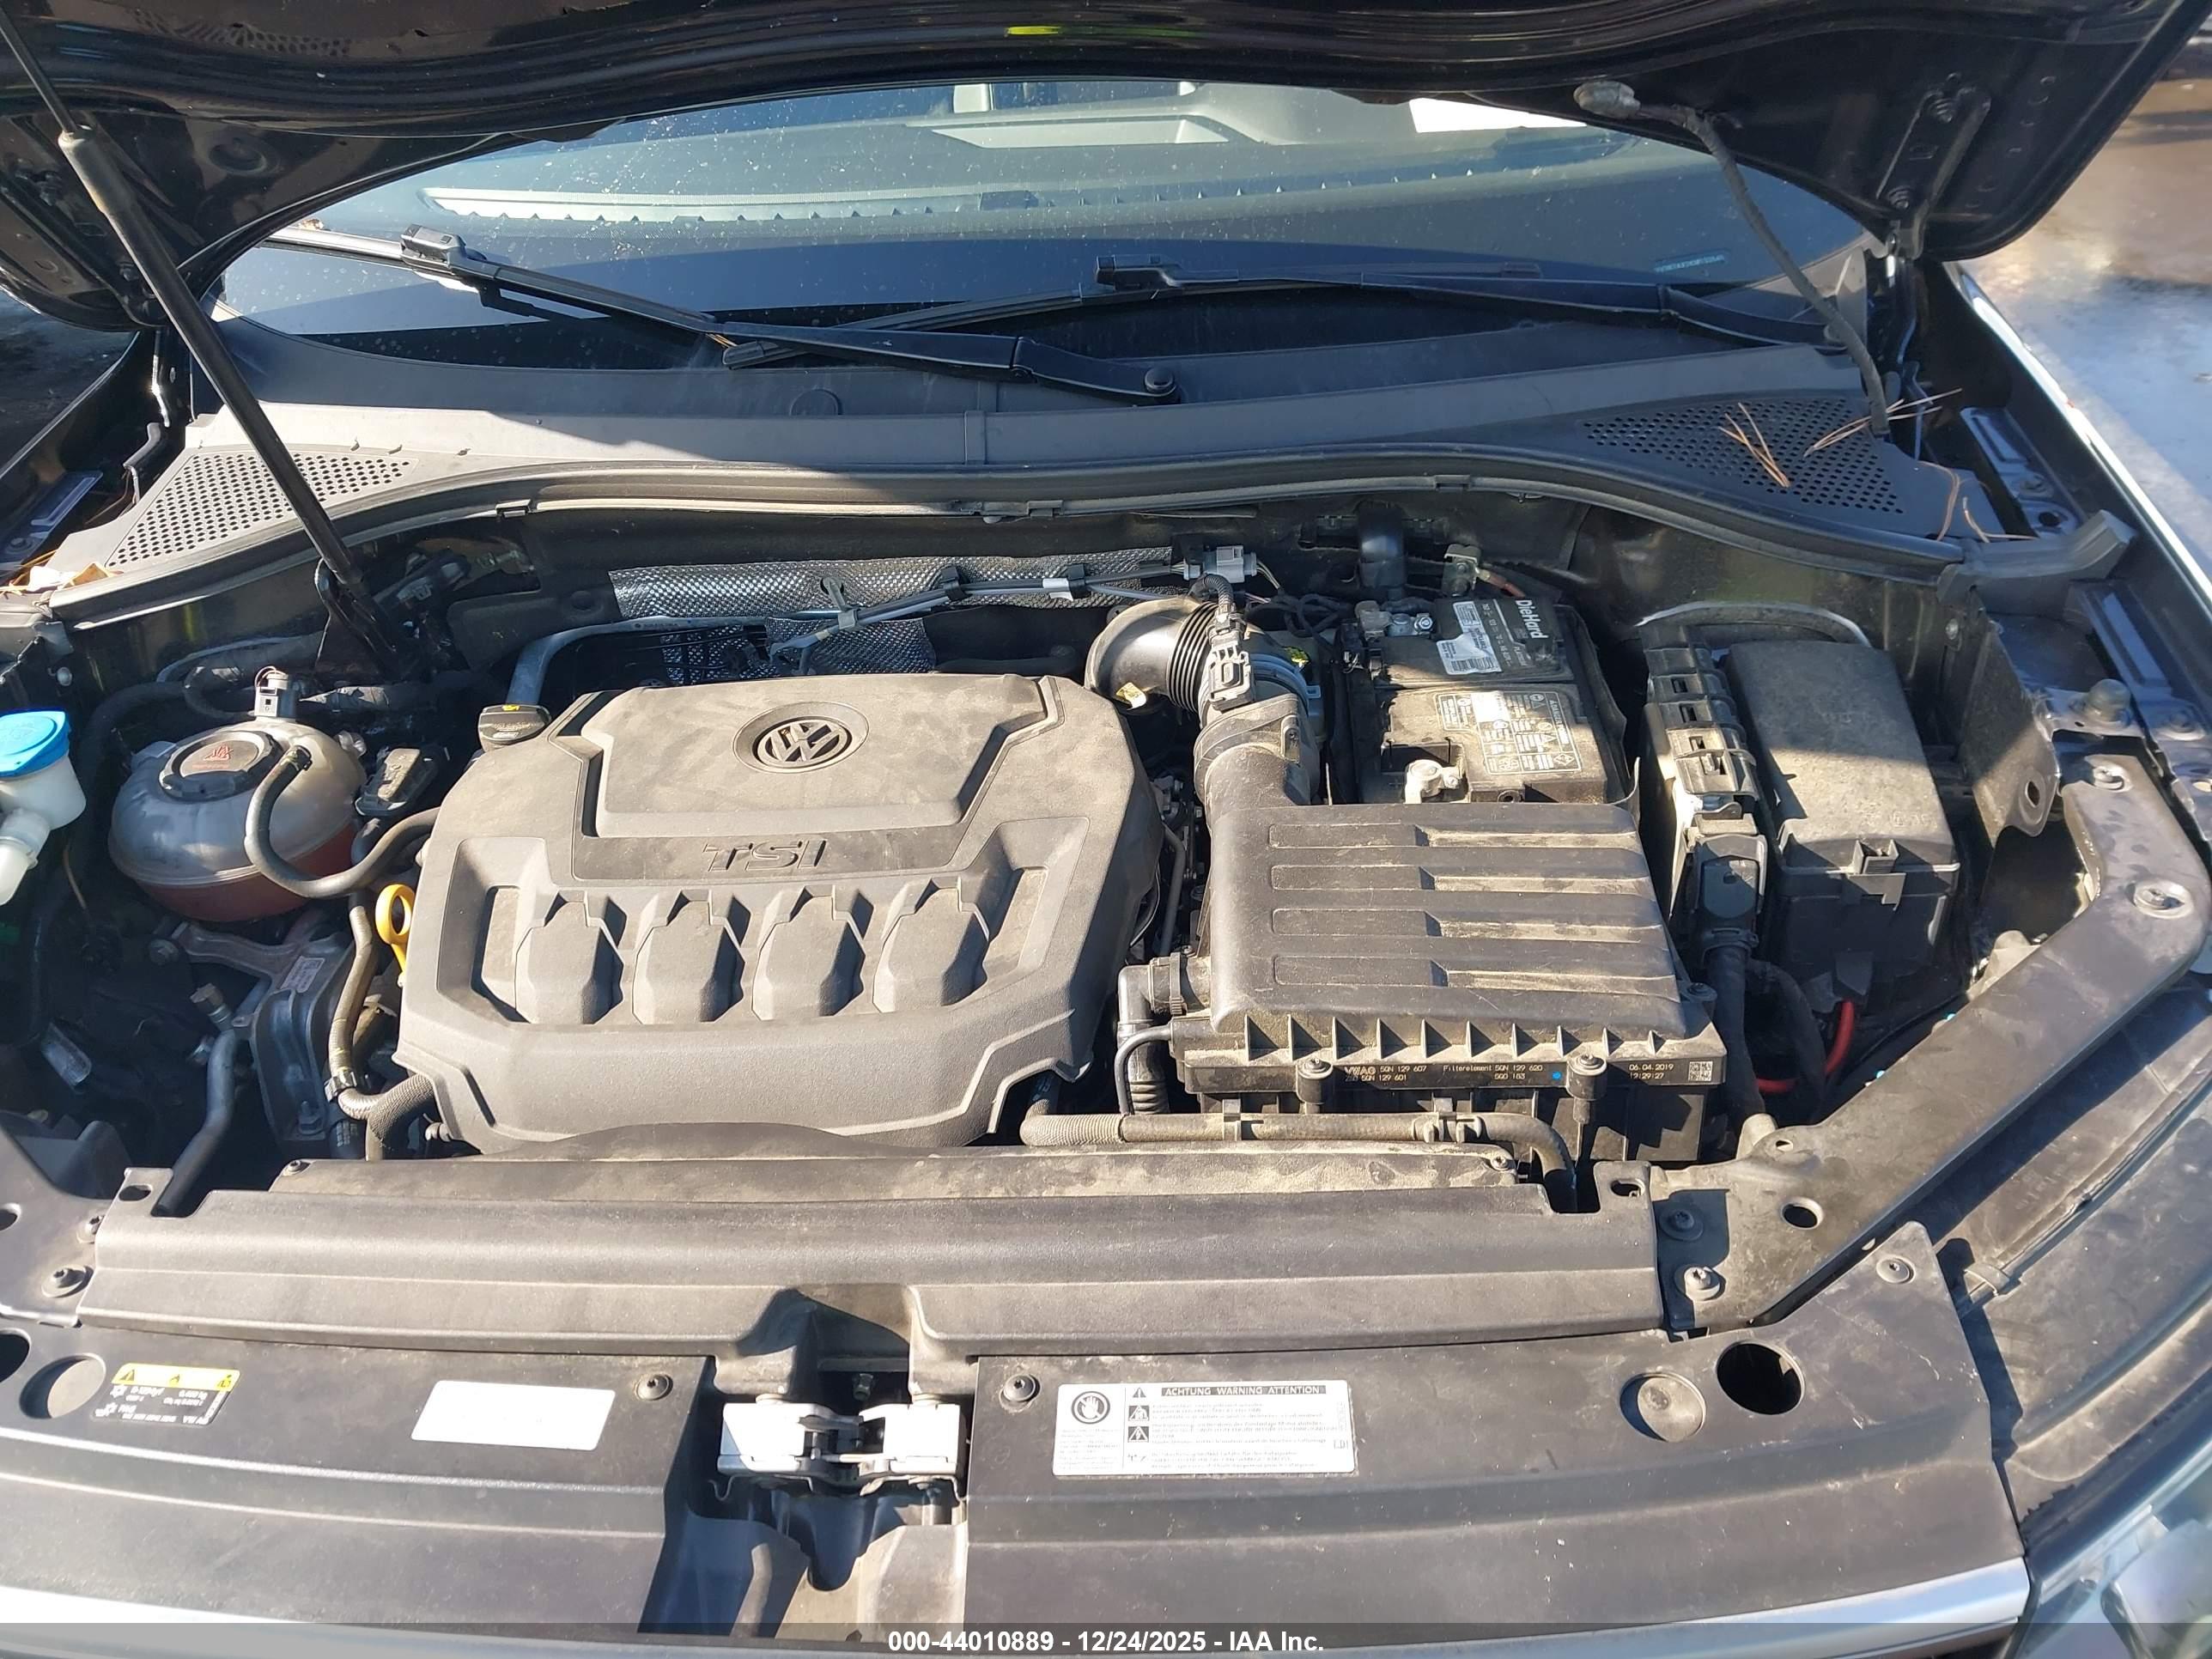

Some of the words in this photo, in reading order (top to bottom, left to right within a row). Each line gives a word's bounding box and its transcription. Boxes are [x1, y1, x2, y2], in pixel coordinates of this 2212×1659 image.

[1516, 599, 1549, 639] DieHard
[757, 720, 848, 769] VW
[702, 839, 828, 872] TSI
[1443, 1064, 1492, 1073] Filterelement
[1628, 1063, 1674, 1072] 06.04.2019
[1164, 1387, 1212, 1396] ACHTUNG
[1216, 1386, 1262, 1395] WARNING
[1268, 1385, 1320, 1395] ATTENTION
